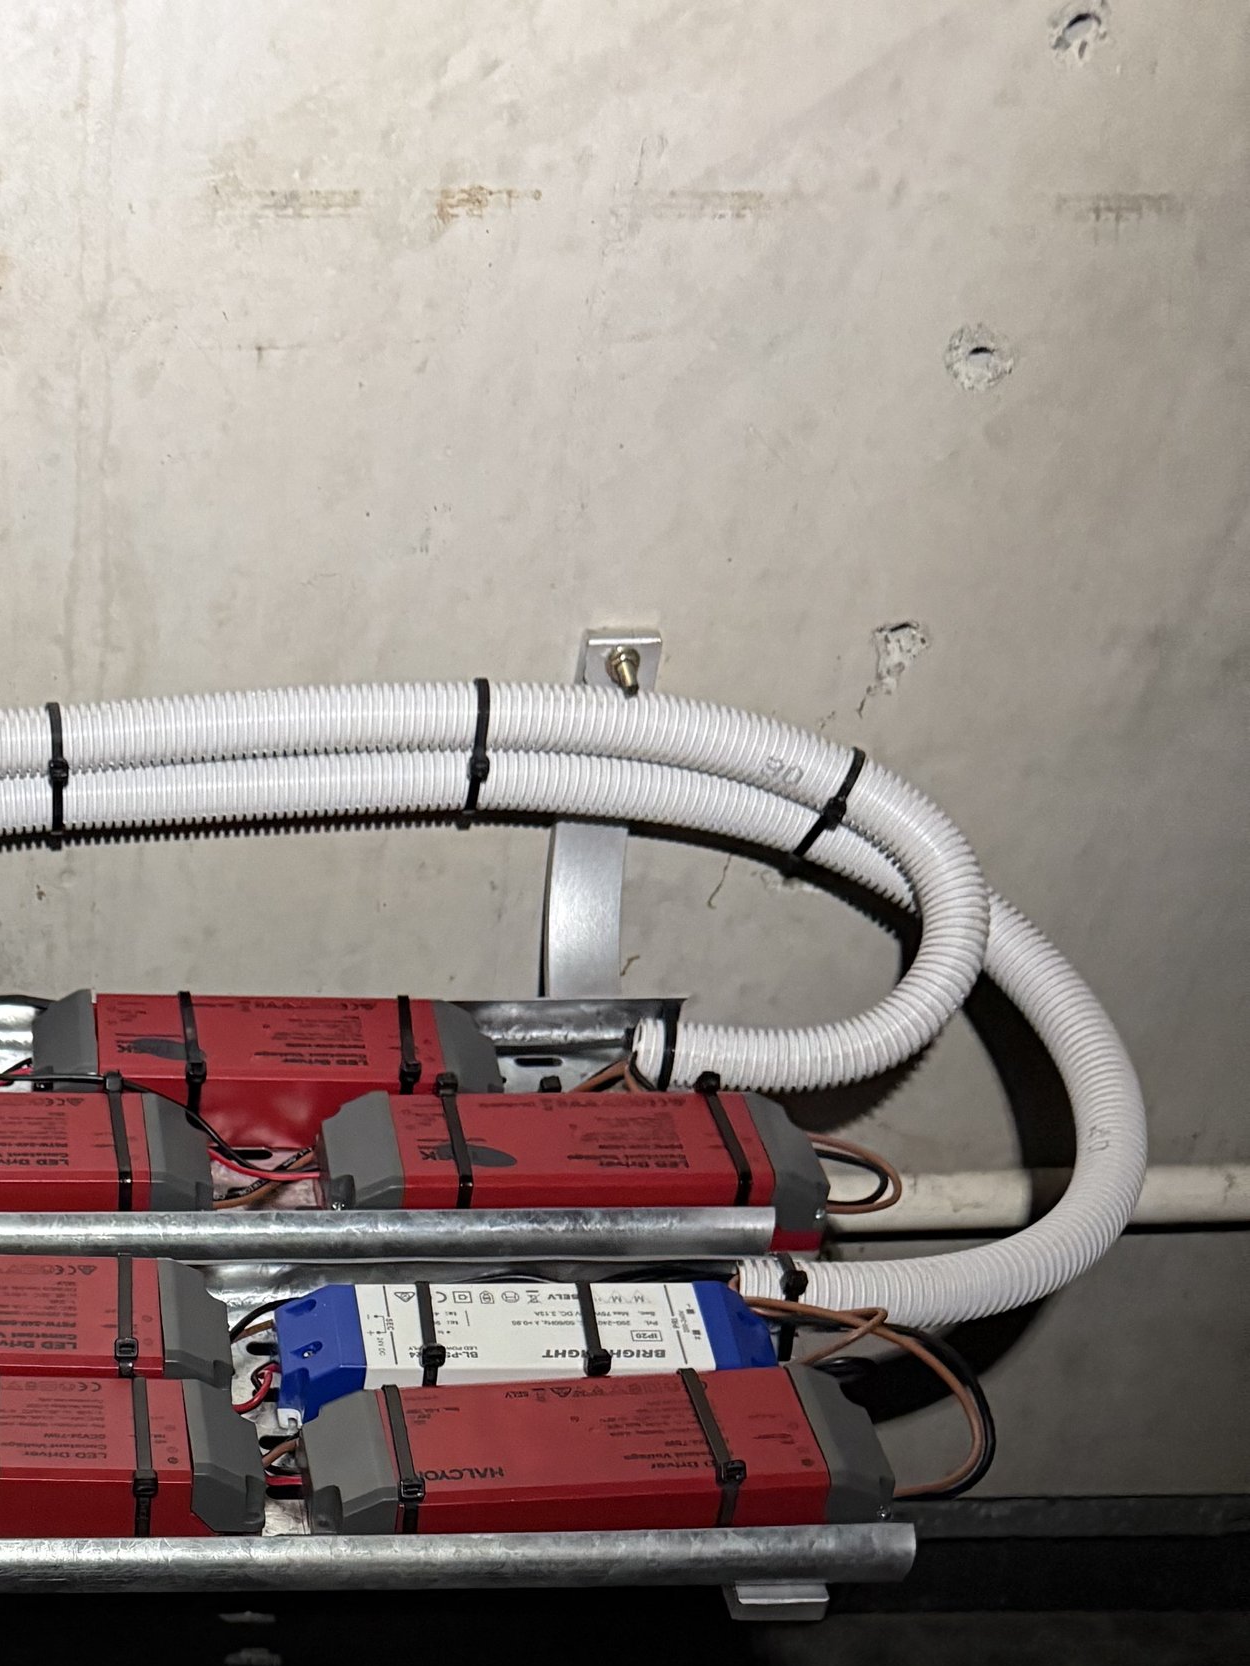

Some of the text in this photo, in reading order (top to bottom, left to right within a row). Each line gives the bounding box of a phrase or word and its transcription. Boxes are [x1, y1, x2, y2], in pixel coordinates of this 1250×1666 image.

[36, 1159, 69, 1167] LED
[547, 1293, 578, 1301] SELV
[41, 1341, 77, 1350] LED
[542, 1348, 666, 1358] BRIGHIGHT
[22, 1451, 107, 1460] LED Driver
[651, 1461, 699, 1470] Driver
